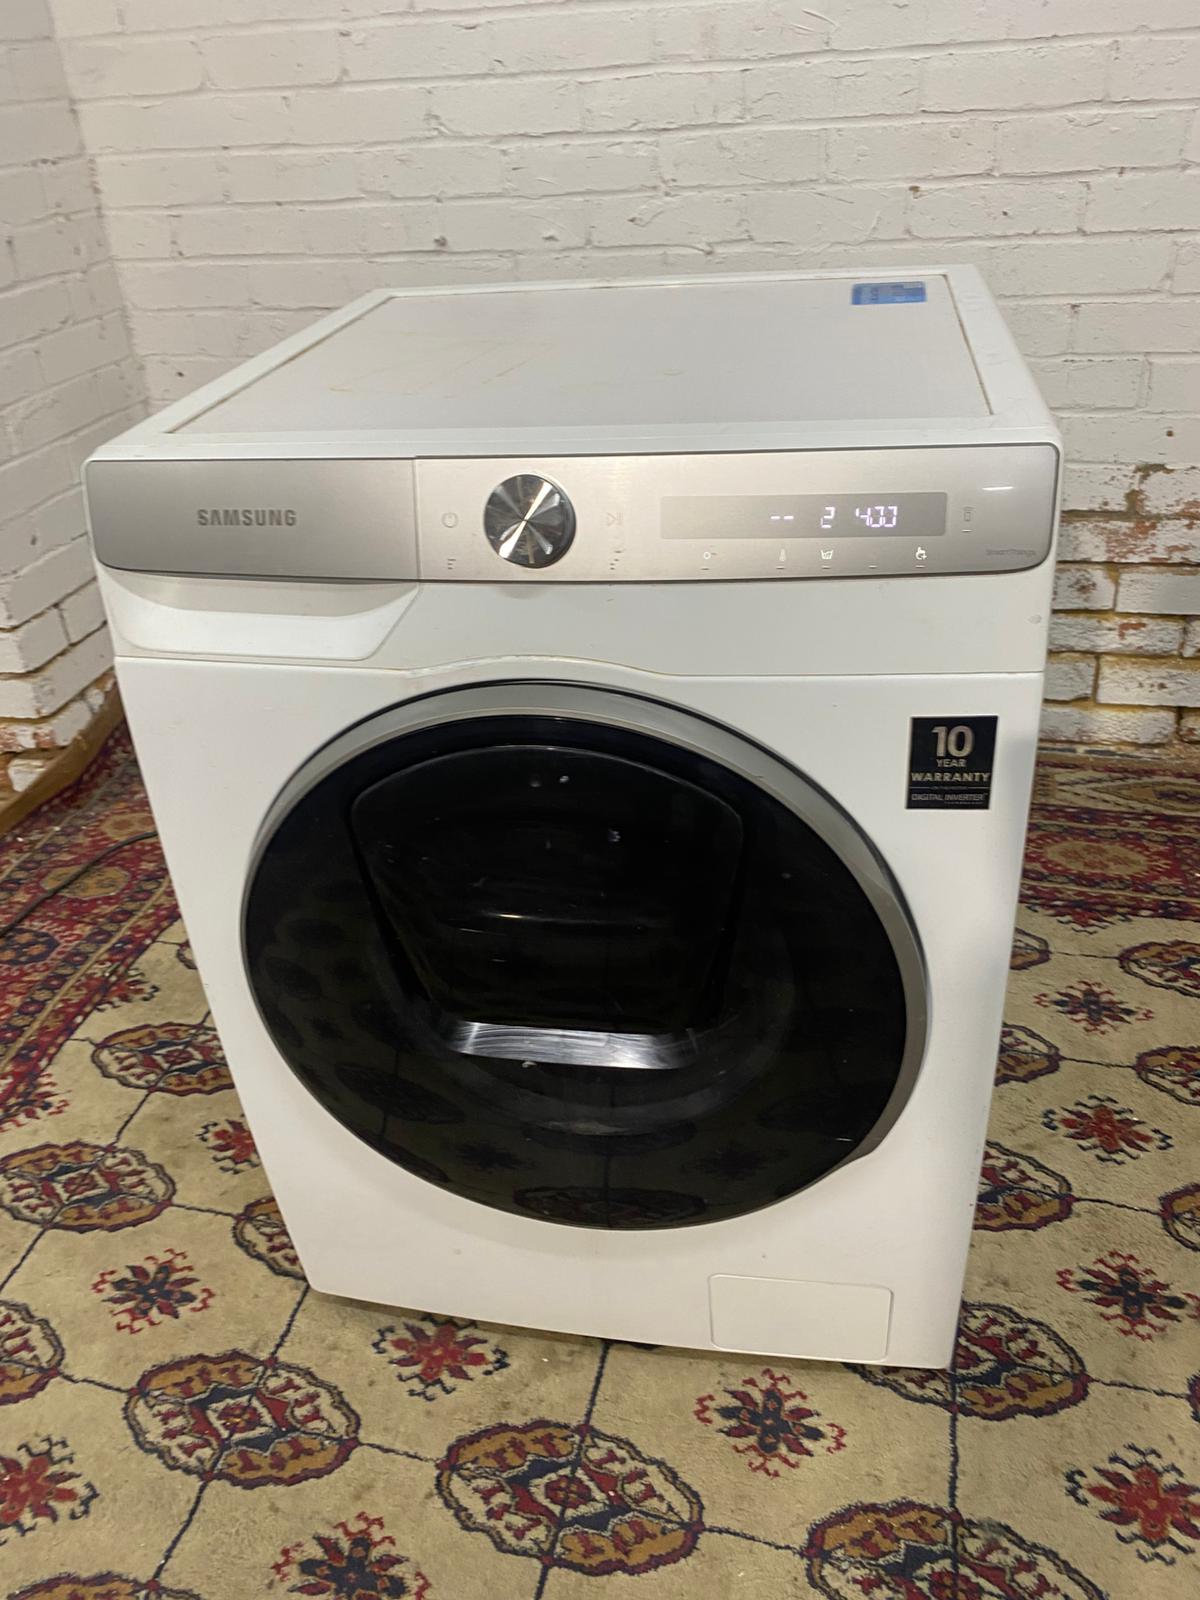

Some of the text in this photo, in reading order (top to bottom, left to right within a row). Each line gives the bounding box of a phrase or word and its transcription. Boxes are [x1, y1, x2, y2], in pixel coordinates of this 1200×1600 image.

[197, 508, 297, 527] SAMSUNG
[820, 506, 835, 529] 2
[931, 725, 974, 757] 10
[936, 758, 966, 768] YEAR
[911, 772, 991, 782] WARRANTY
[911, 793, 984, 801] DIGITAL INVERTER
